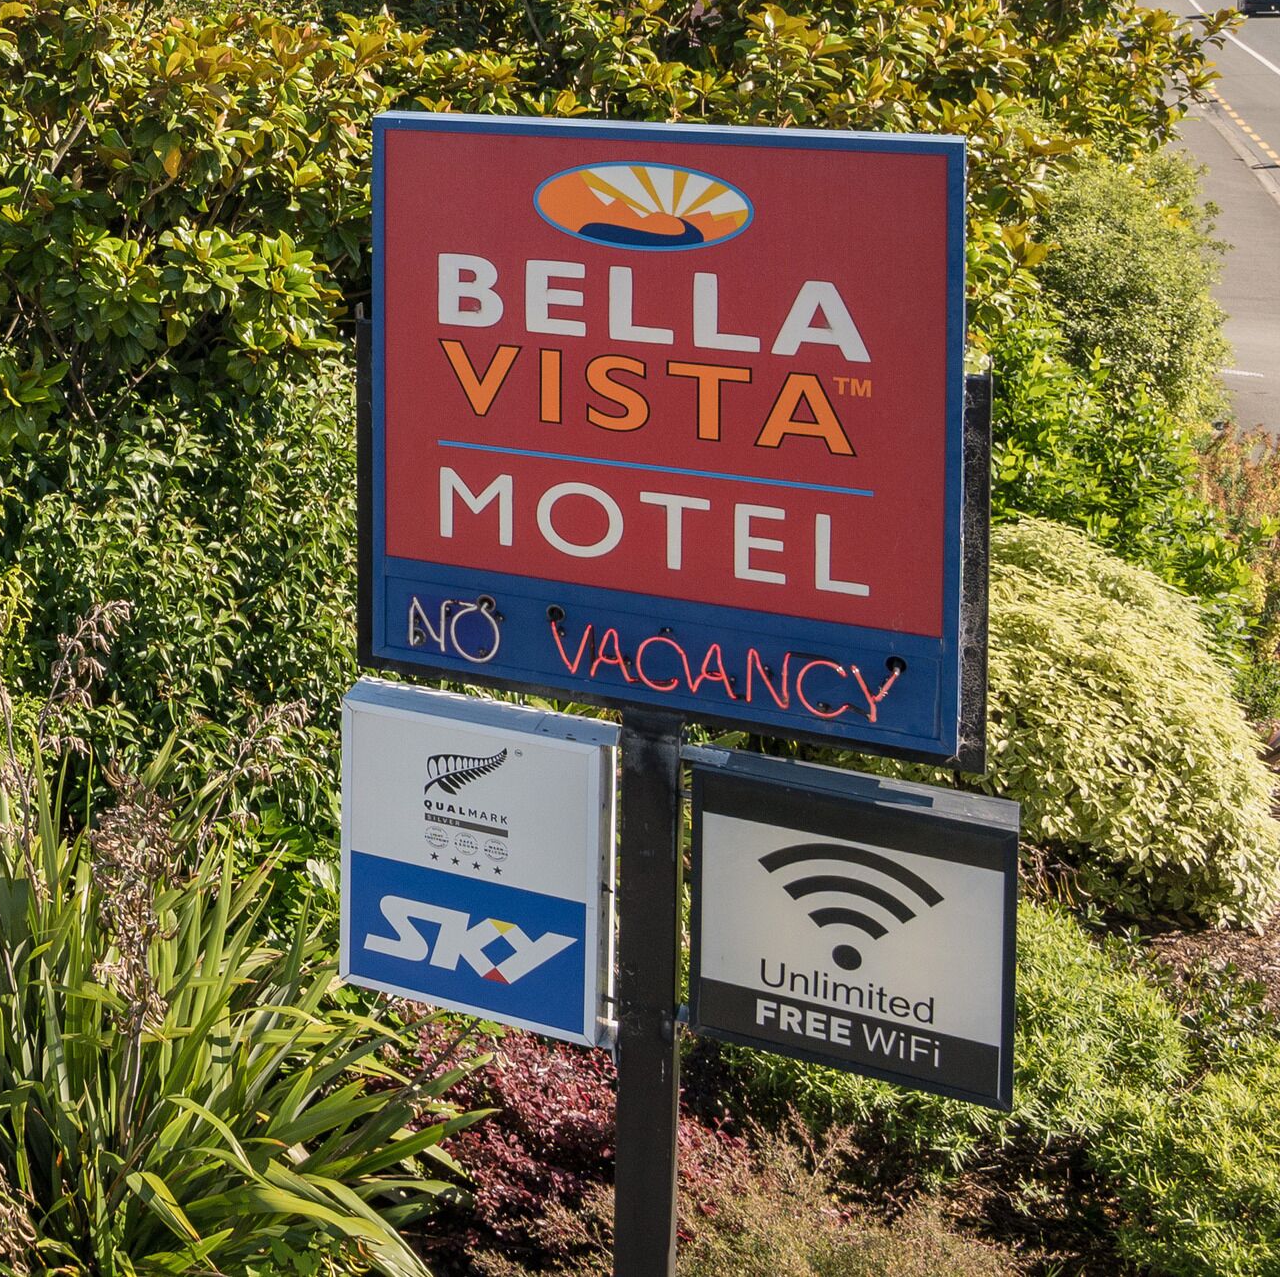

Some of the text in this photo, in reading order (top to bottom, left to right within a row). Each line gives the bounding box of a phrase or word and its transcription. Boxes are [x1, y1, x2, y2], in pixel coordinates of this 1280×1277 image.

[438, 252, 871, 363] BELLA
[440, 338, 857, 456] VISTA
[438, 466, 869, 596] MOTEL
[409, 595, 901, 722] NO VACANCY
[424, 799, 508, 825] QUALMARK
[426, 813, 461, 827] SILVER
[363, 895, 578, 984] SKY
[756, 998, 940, 1068] FREE WiFi
[759, 958, 934, 1025] Unlimited
